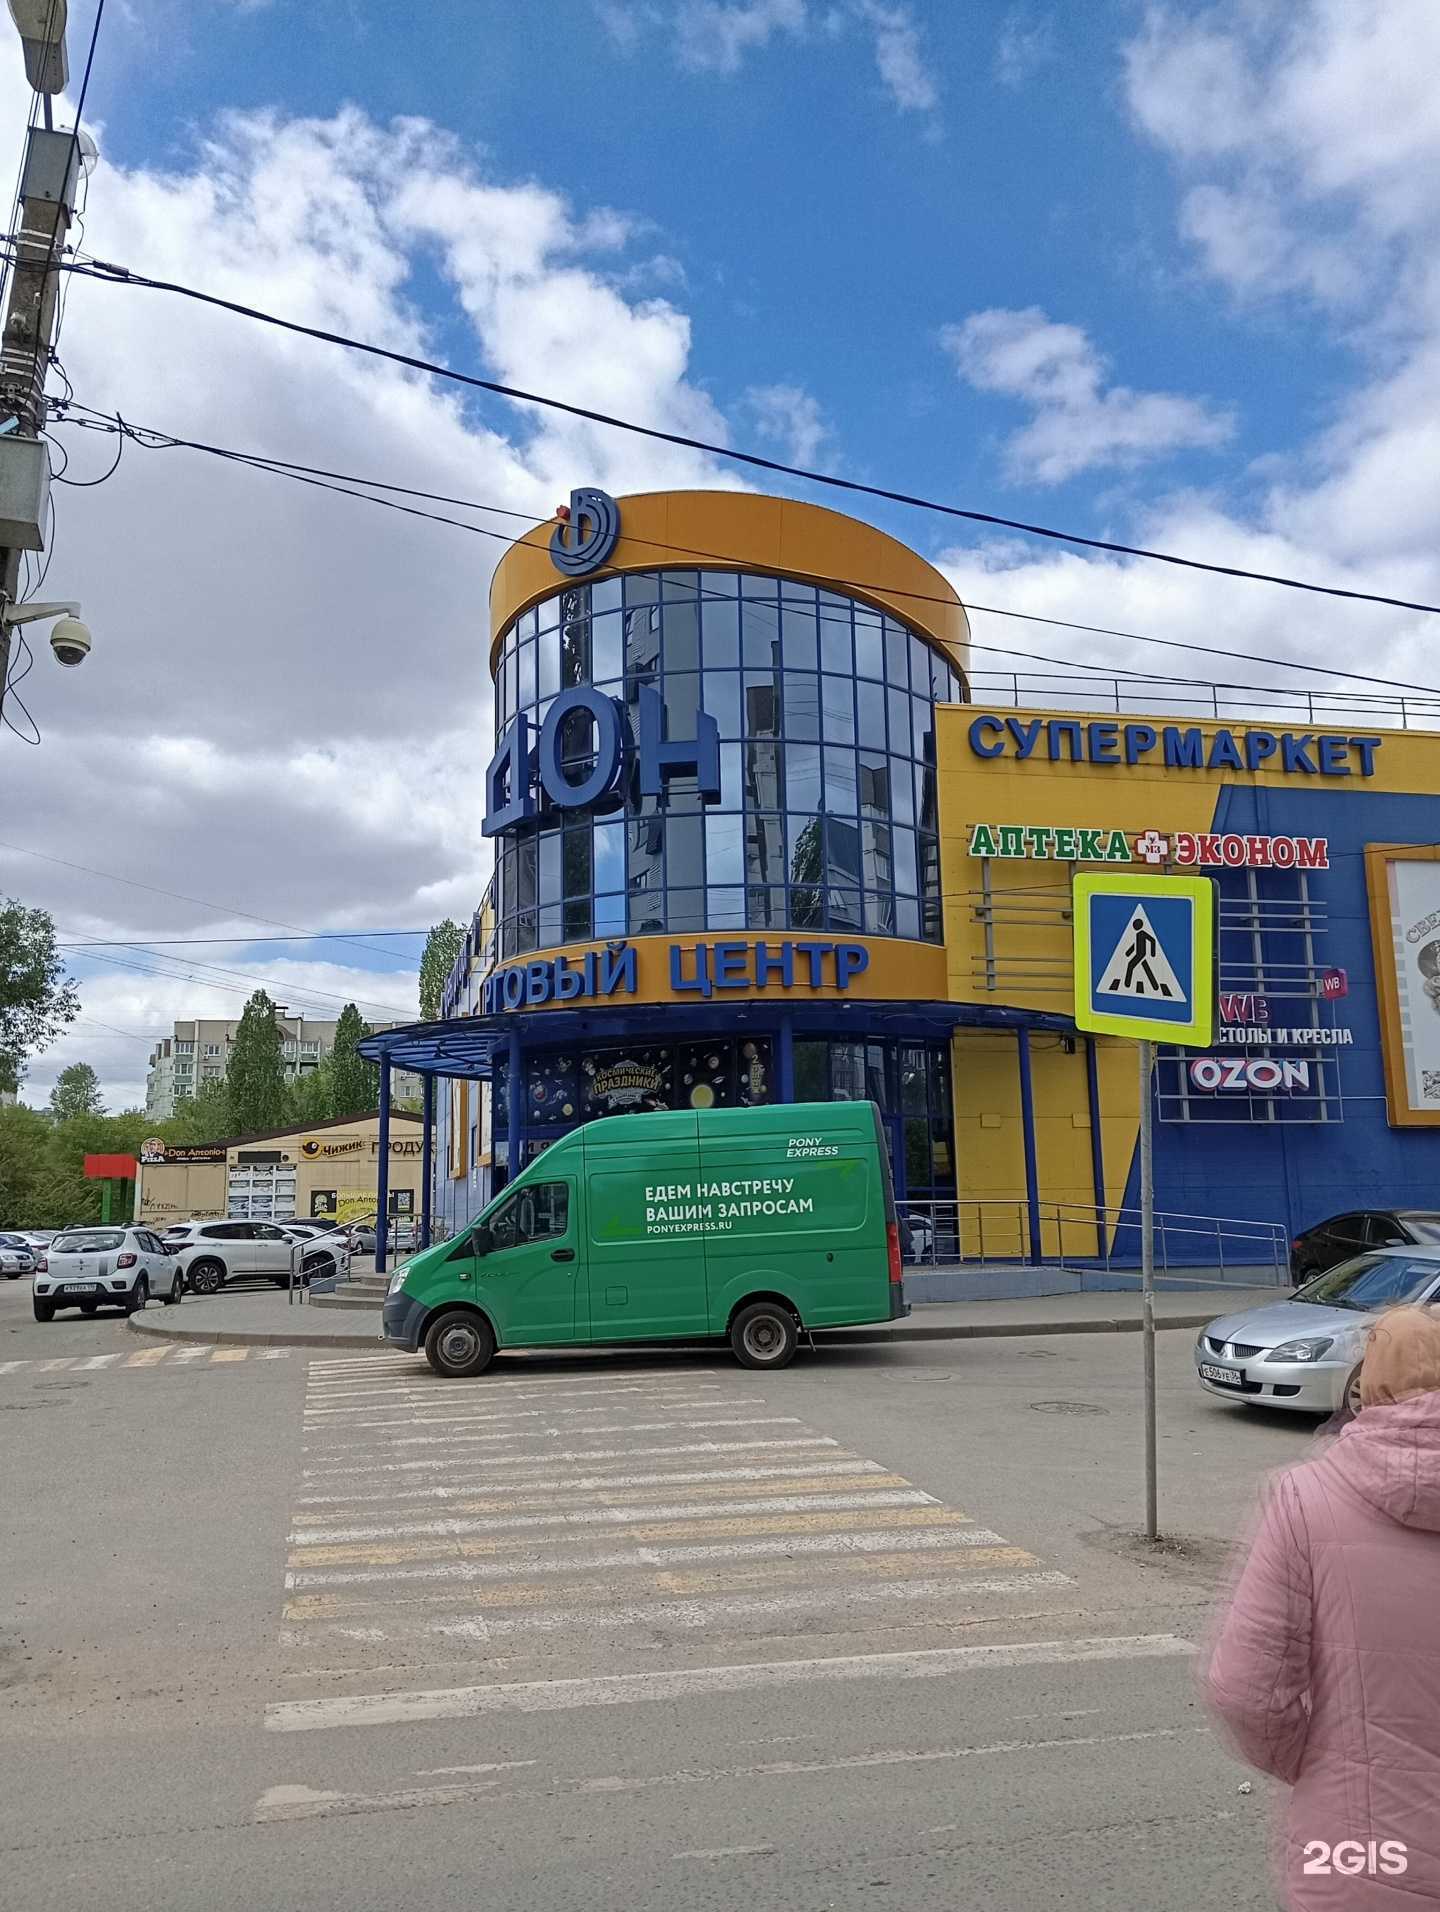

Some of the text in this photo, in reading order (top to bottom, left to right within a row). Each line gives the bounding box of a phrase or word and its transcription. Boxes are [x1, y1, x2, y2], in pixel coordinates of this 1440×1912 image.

[968, 714, 1382, 777] СУПЕРМАРКЕТ
[481, 686, 721, 838] ДОН
[968, 824, 1132, 863] АПТЕКА
[1174, 832, 1329, 870] ЭКОНОМ
[1406, 910, 1440, 944] СВЕ
[669, 941, 870, 998] ЦЕНТР
[1324, 976, 1341, 991] WB
[1219, 1027, 1354, 1045] СТОЛЫ И КРЕСЛА
[592, 1075, 659, 1094] ПРАЗДНИКИ
[1191, 1058, 1311, 1092] OZON
[168, 1148, 186, 1157] Don
[323, 1141, 363, 1156] Чижик
[786, 1146, 839, 1158] EXPRESS
[788, 1137, 823, 1147] PONY
[645, 1178, 795, 1203] ЕДЕМ НАВСТРЕЧУ
[646, 1198, 814, 1222] ВАШИМ ЗАПРОСАМ
[646, 1221, 733, 1235] PONYEXPRESS.RU
